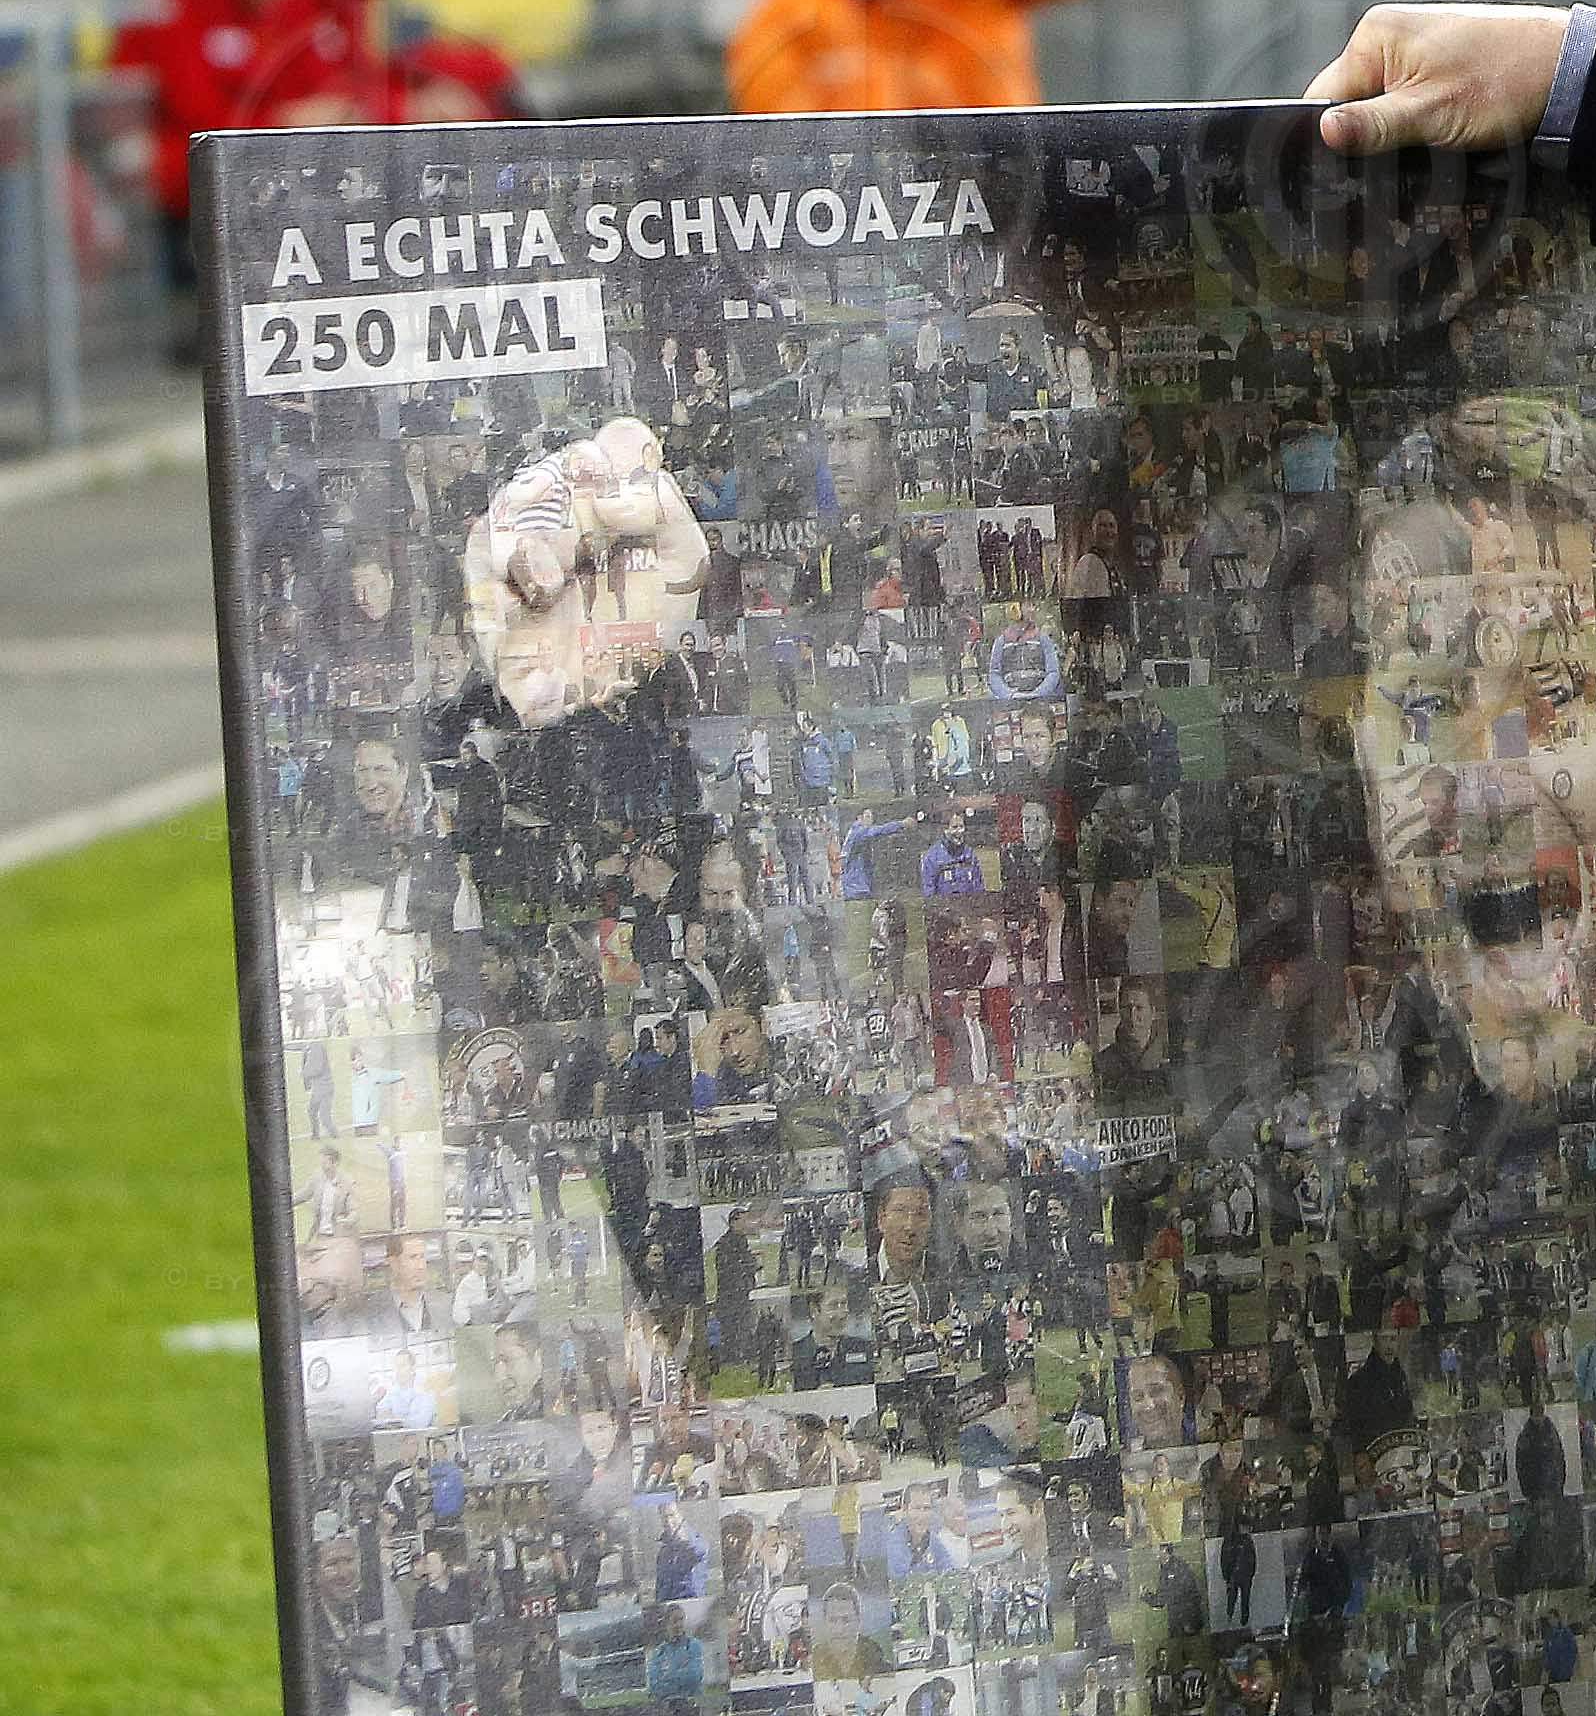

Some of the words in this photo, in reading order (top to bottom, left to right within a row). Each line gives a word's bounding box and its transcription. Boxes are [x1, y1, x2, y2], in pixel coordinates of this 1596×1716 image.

[272, 227, 322, 287] A
[344, 209, 566, 282] ECHTA
[586, 179, 995, 265] SCHWOAZA
[260, 308, 395, 378] 250
[426, 293, 577, 362] MAL
